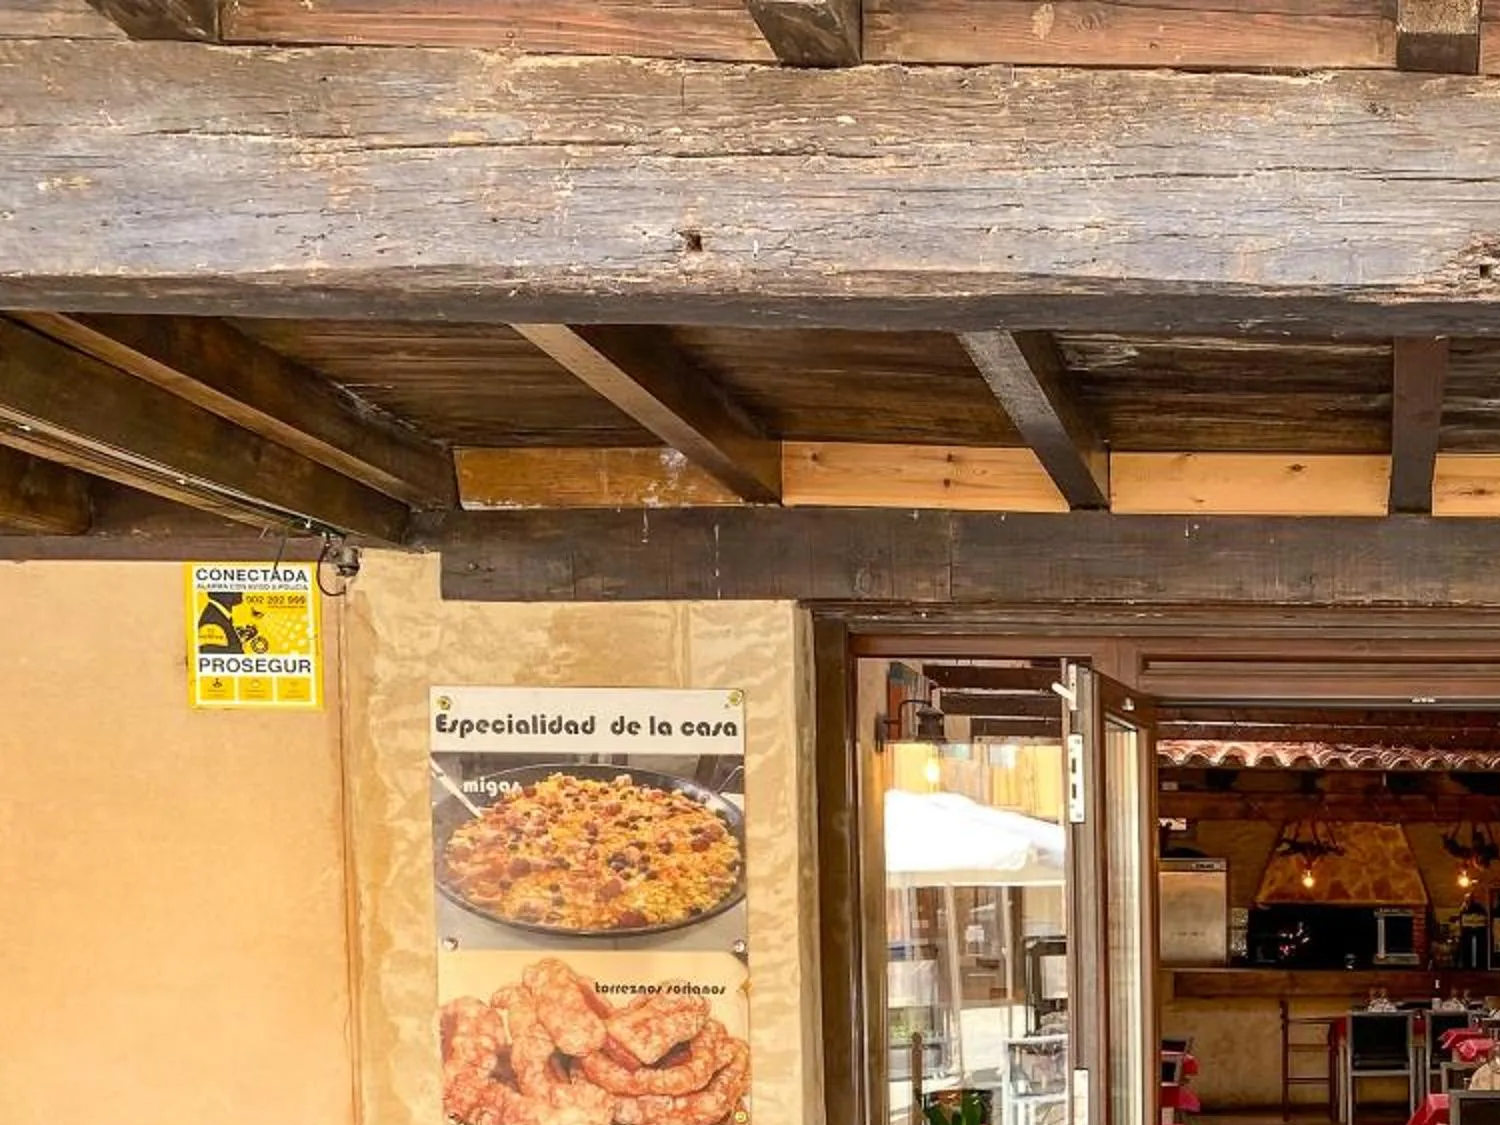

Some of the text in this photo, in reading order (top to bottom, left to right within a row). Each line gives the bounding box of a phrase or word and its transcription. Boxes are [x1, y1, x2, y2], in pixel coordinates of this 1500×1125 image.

[196, 568, 308, 582] CONECTADA
[198, 657, 312, 673] PROSEGUR
[435, 713, 738, 738] Especialidad de la casa
[463, 775, 523, 797] migas
[594, 981, 727, 995] torreznos sorianos
